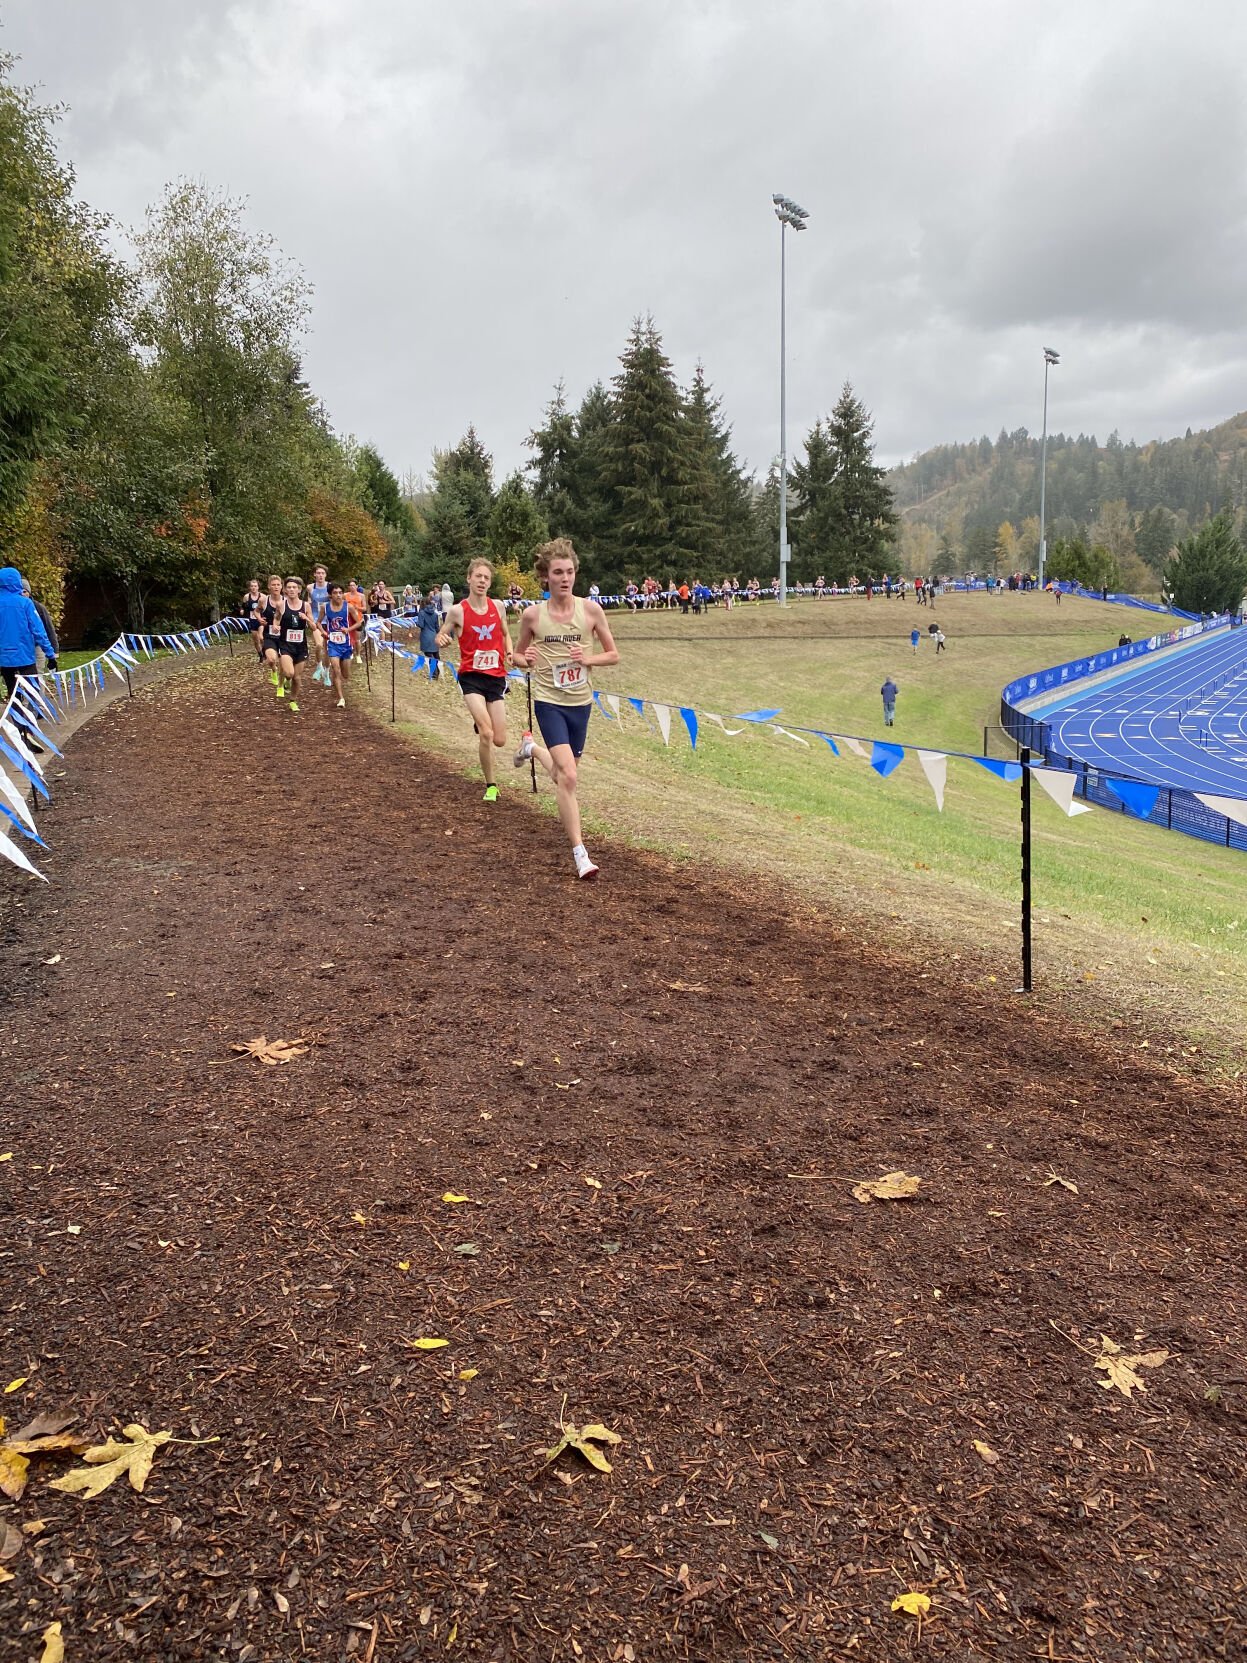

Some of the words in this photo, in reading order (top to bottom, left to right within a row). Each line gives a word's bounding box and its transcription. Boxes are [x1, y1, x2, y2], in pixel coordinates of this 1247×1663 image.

[544, 635, 562, 643] HOOD
[562, 634, 582, 642] RIVER
[477, 656, 494, 666] 741
[559, 667, 582, 684] 787
